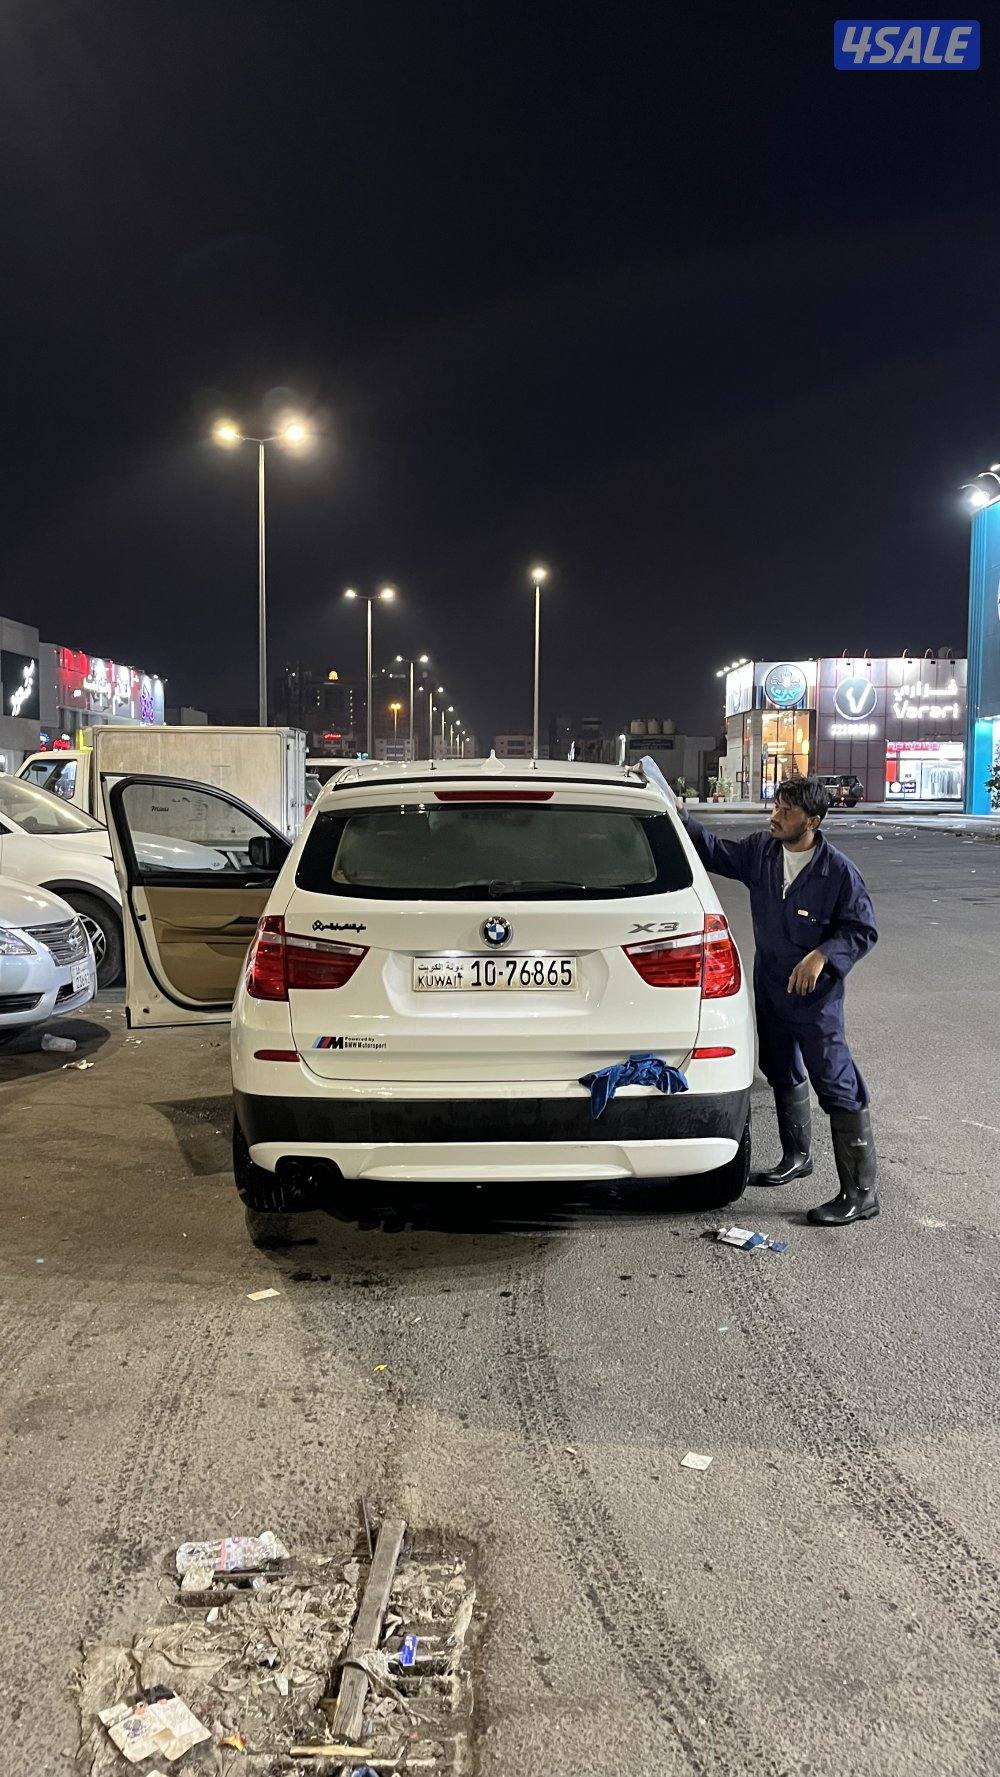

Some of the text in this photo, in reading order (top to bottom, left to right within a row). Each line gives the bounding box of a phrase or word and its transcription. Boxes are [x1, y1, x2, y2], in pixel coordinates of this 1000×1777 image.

[893, 700, 958, 719] Varari
[628, 921, 680, 934] X3
[418, 975, 464, 987] KUWAIT
